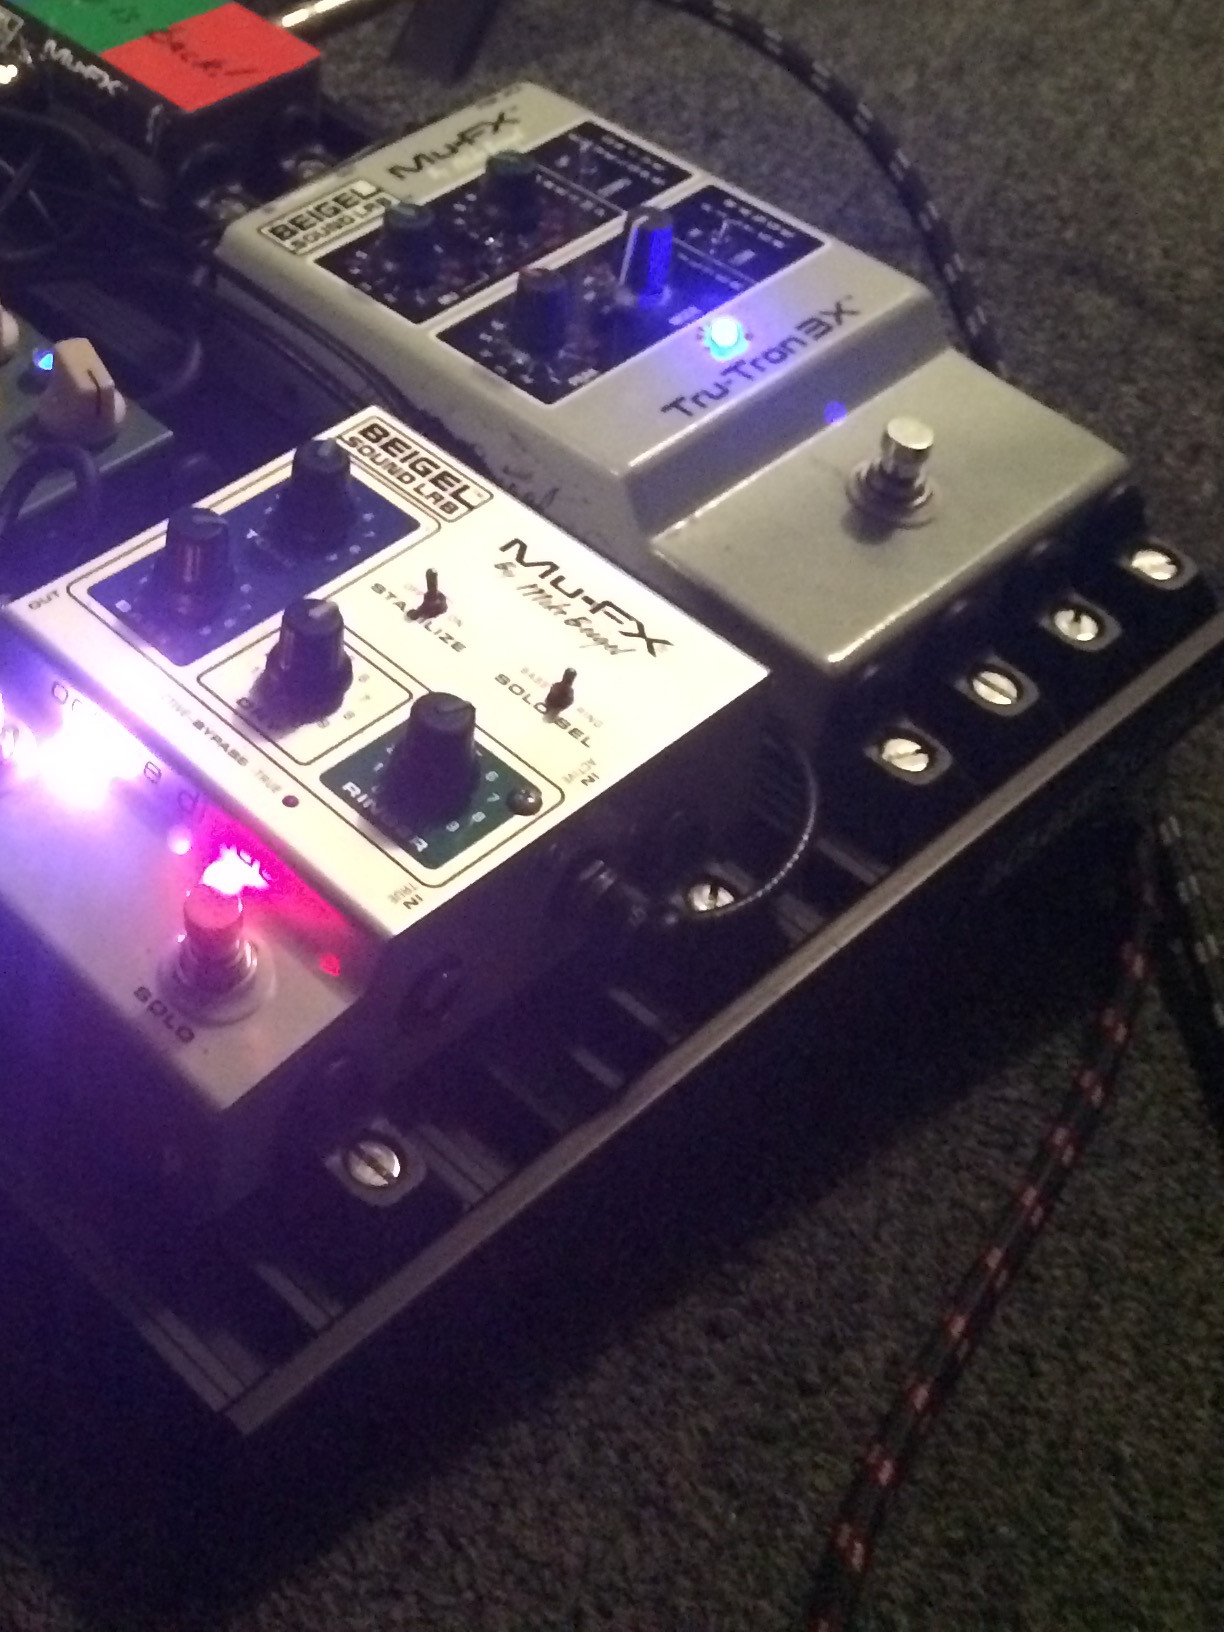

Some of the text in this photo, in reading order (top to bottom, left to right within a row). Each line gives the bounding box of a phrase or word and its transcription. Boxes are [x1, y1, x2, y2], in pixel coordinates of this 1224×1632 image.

[269, 187, 383, 241] BEIGEL
[343, 435, 416, 485] SOUND
[413, 483, 460, 515] LAB
[358, 422, 475, 511] BEIGEL
[499, 537, 675, 658] Mu-FX
[494, 672, 549, 716] SOLO
[133, 985, 196, 1044] SOLO
